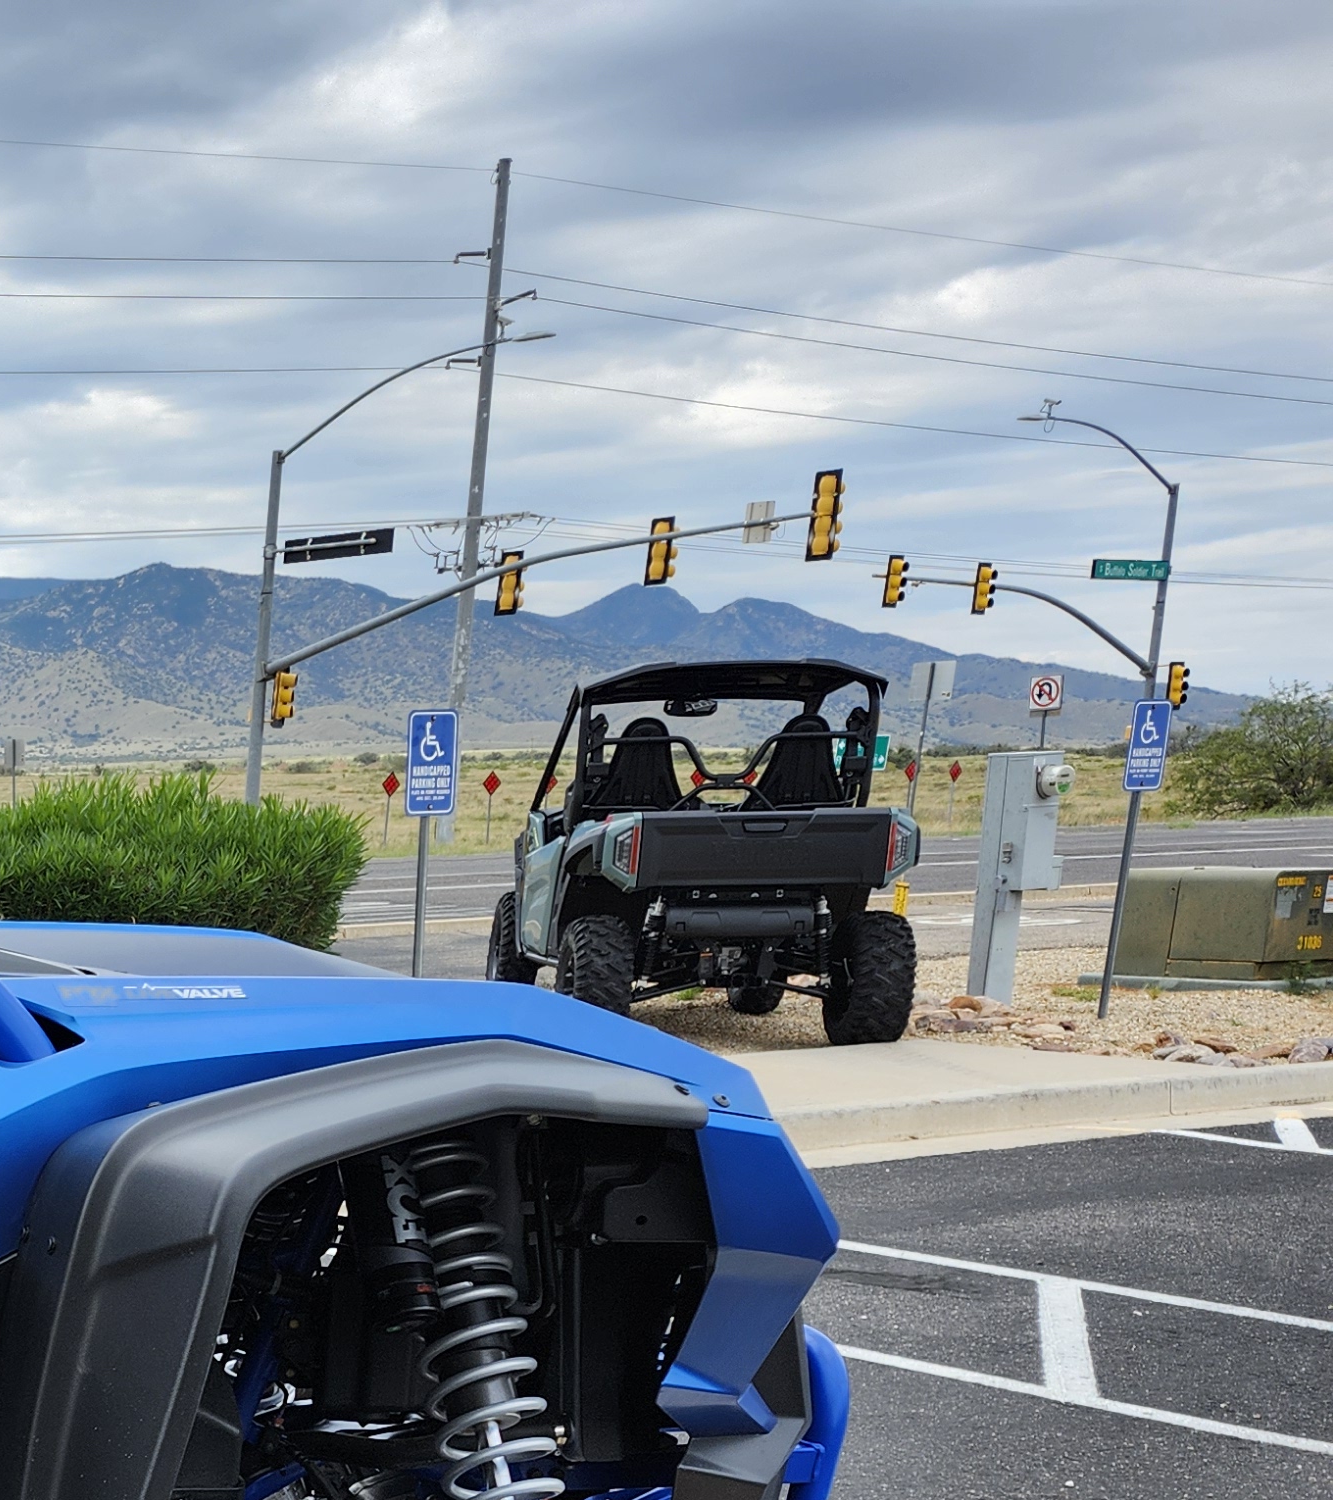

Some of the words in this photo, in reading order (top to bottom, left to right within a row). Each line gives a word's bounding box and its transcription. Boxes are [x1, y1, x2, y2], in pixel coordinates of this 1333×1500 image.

[1104, 562, 1126, 577] Buffalo
[1127, 563, 1149, 577] Soldier
[1151, 564, 1165, 577] Trail
[413, 765, 451, 777] HANDICAPPED
[411, 777, 436, 789] PARKING
[436, 776, 451, 788] ONLY
[172, 987, 247, 999] VALVE
